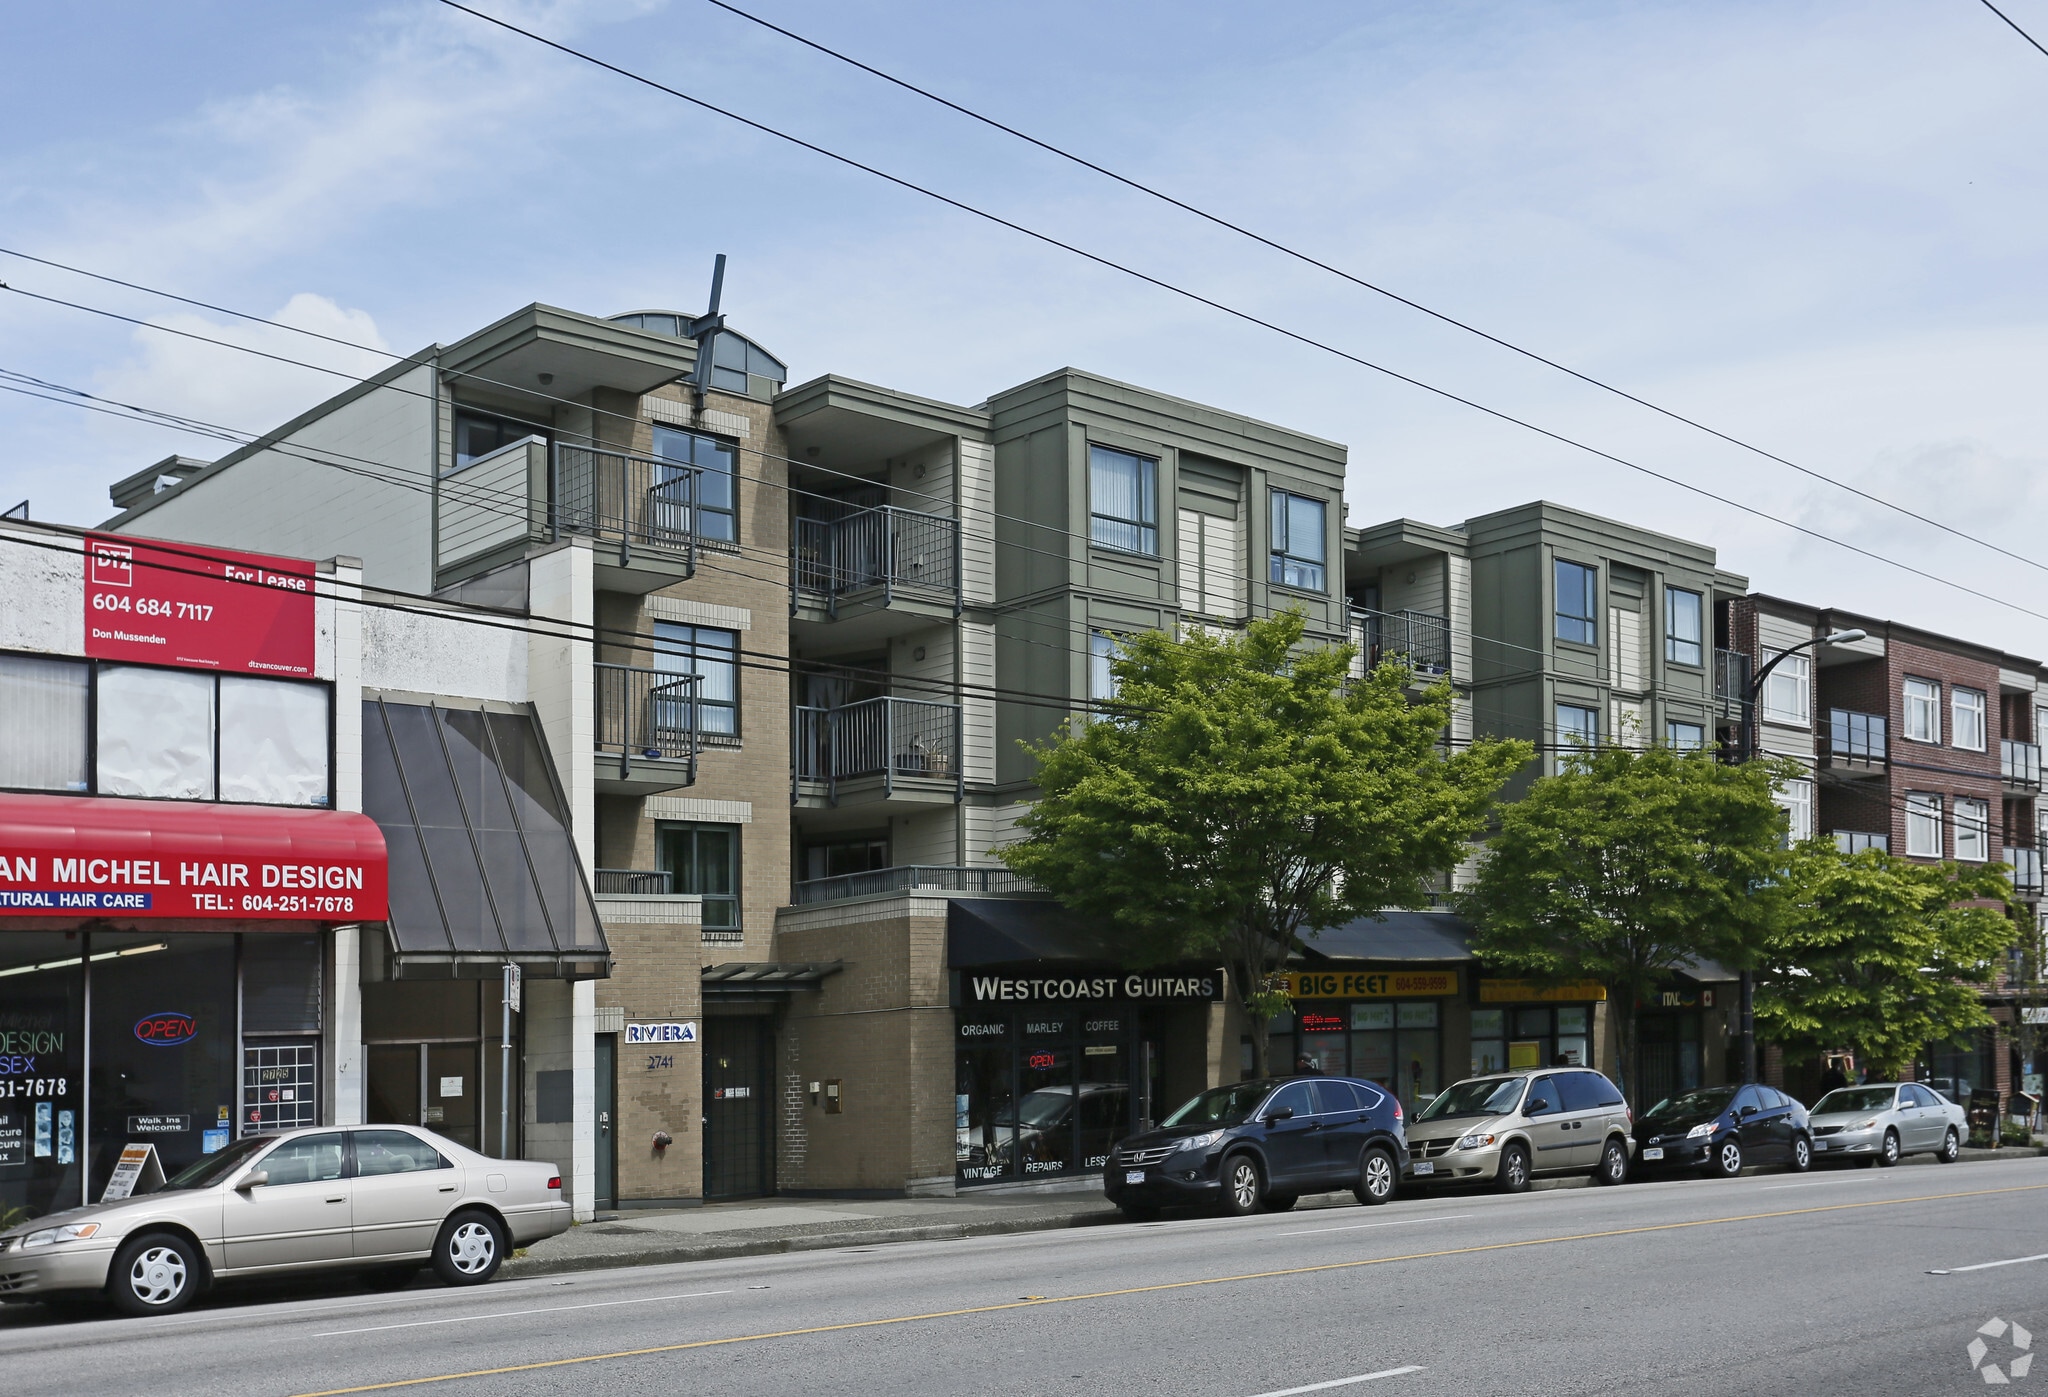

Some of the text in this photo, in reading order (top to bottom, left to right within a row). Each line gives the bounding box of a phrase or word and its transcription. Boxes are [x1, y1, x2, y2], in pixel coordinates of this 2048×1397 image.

[97, 548, 131, 570] DTZ
[225, 565, 306, 591] For Lease
[93, 593, 213, 621] 604 684 7117
[92, 628, 166, 645] Don Mussenden
[248, 660, 307, 673] dtzvancouver.com
[53, 858, 170, 885] MICHEL
[180, 862, 249, 887] HAIR
[262, 864, 363, 890] DESIGN
[0, 892, 144, 908] TURAL HAIR CARE
[192, 893, 354, 912] TEL: 604-251-7678
[972, 975, 1214, 1001] WESTCOAST GUITARS
[1299, 975, 1338, 995] BIG
[1343, 974, 1389, 994] FEET
[137, 1019, 196, 1038] OPEN
[628, 1025, 693, 1042] RIVIERA
[961, 1020, 1119, 1036] ORGANIC MARLEY COFFEE
[0, 1056, 35, 1074] SEX
[648, 1055, 673, 1069] 2741
[1029, 1055, 1055, 1068] OPEN
[263, 1068, 289, 1080] 2725
[963, 1155, 1110, 1179] VINTAGE REPAIRS LESS
